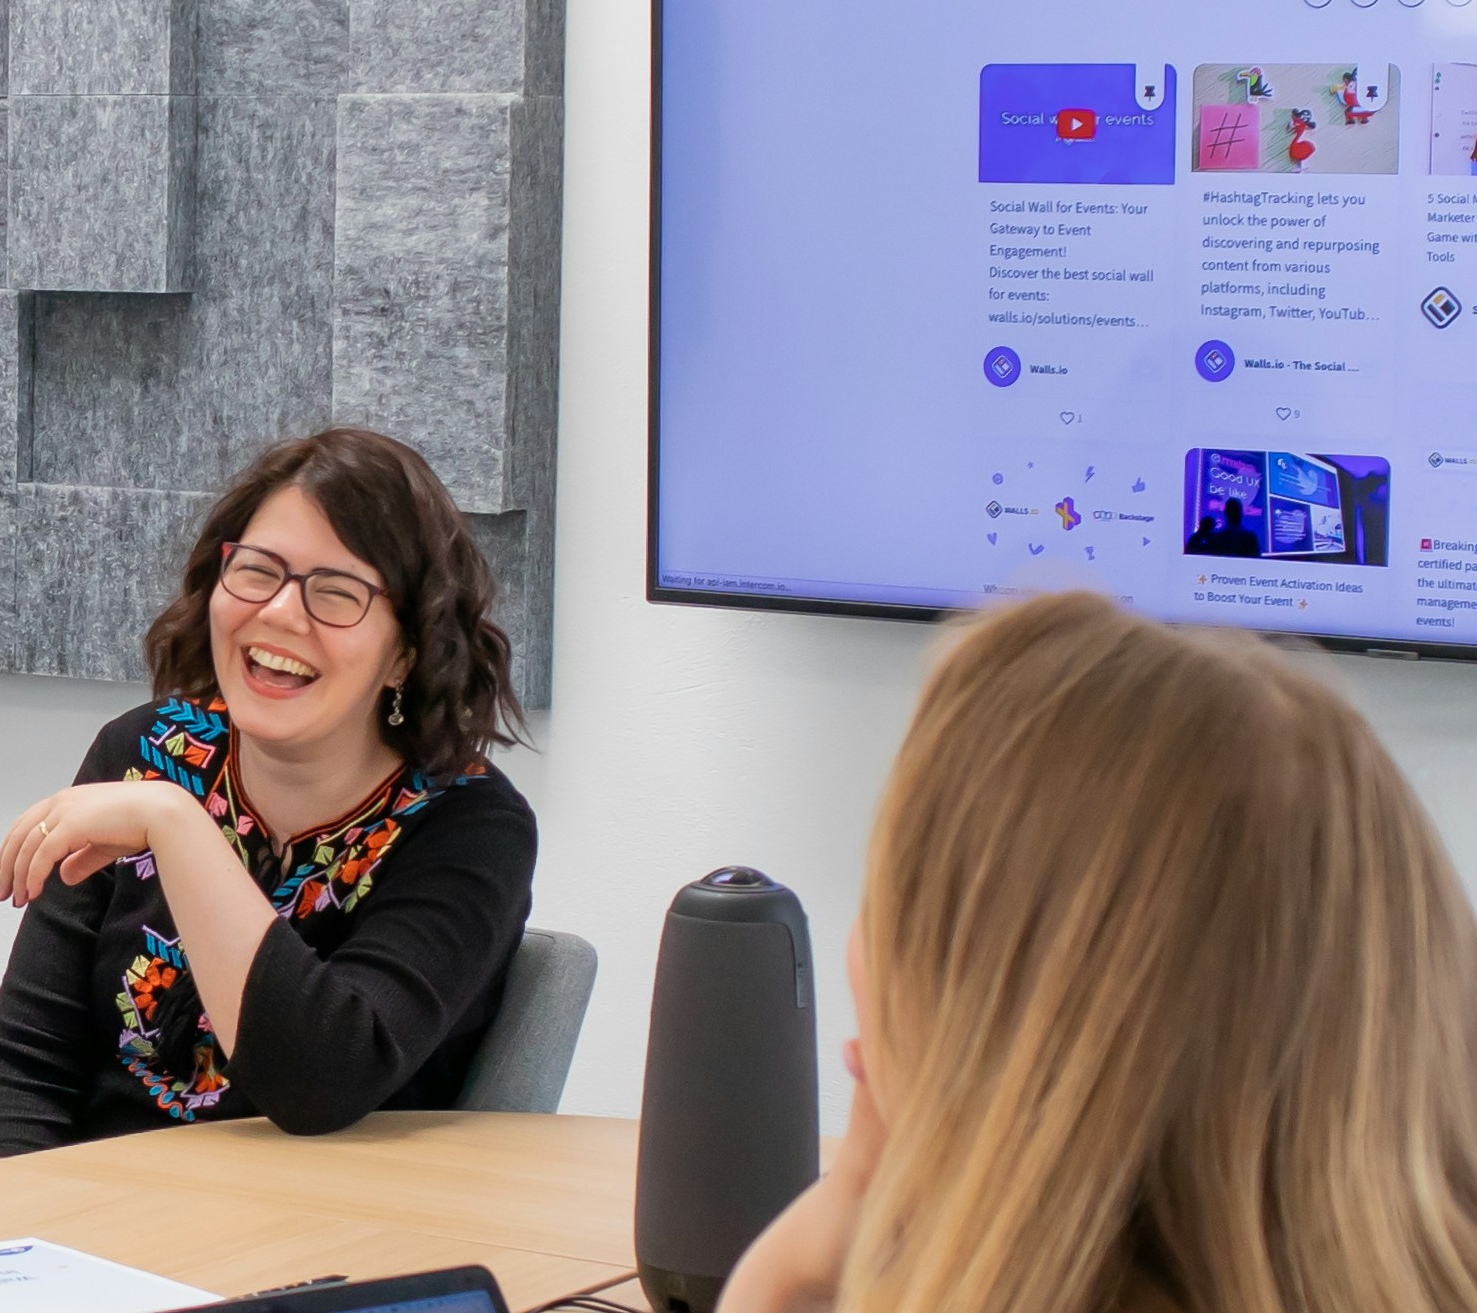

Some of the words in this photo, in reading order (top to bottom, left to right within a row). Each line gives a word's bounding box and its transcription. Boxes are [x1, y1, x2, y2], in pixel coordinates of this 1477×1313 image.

[1000, 111, 1044, 126] Social
[1104, 113, 1155, 127] events
[1202, 190, 1314, 208] #HashtagTracking
[1317, 192, 1339, 205] lets
[1341, 194, 1366, 208] you
[1436, 193, 1469, 205] Social
[989, 200, 1026, 214] Social
[1027, 200, 1053, 214] Wall
[1055, 200, 1072, 214] for
[1075, 201, 1119, 215] Events:
[1120, 202, 1149, 215] Your
[1202, 212, 1244, 226] unlock
[1247, 213, 1268, 227] the
[1270, 216, 1311, 230] power
[1313, 214, 1327, 228] of
[1427, 212, 1476, 224] Marketer
[989, 222, 1040, 238] Gateway
[1042, 224, 1055, 236] to
[1058, 223, 1092, 236] Event
[1426, 231, 1459, 244] Game
[989, 244, 1067, 260] Engagement!
[1202, 235, 1273, 253] discovering
[1275, 237, 1300, 250] and
[1302, 239, 1381, 255] repurposing
[1426, 250, 1456, 263] Tools
[1201, 259, 1249, 272] content
[1251, 258, 1282, 272] from
[1284, 260, 1331, 274] various
[989, 266, 1040, 280] Discover
[1041, 267, 1061, 280] the
[1063, 268, 1089, 281] best
[1091, 269, 1126, 282] social
[1129, 269, 1154, 282] wall
[988, 287, 1004, 301] for
[1007, 289, 1051, 302] events:
[1200, 281, 1265, 297] platforms,
[1267, 281, 1326, 300] including
[1200, 303, 1267, 320] Instagram,
[1268, 305, 1316, 321] Twitter,
[1029, 364, 1069, 375] Walls.io
[1244, 358, 1285, 370] Walls.io
[1292, 360, 1312, 371] The
[1314, 361, 1346, 372] Social
[1209, 467, 1243, 485] Good
[1246, 474, 1263, 488] UX
[1417, 558, 1463, 572] certified
[661, 573, 692, 587] Waiting
[693, 575, 705, 586] for
[1211, 573, 1247, 587] Proven
[1249, 575, 1279, 588] Event
[1280, 577, 1333, 592] Activation
[1335, 581, 1364, 594] Ideas
[1417, 577, 1435, 589] the
[1193, 590, 1206, 602] to
[1207, 592, 1237, 605] Boost
[1238, 593, 1262, 606] Your
[1264, 595, 1294, 608] Event
[1415, 615, 1456, 629] events!
